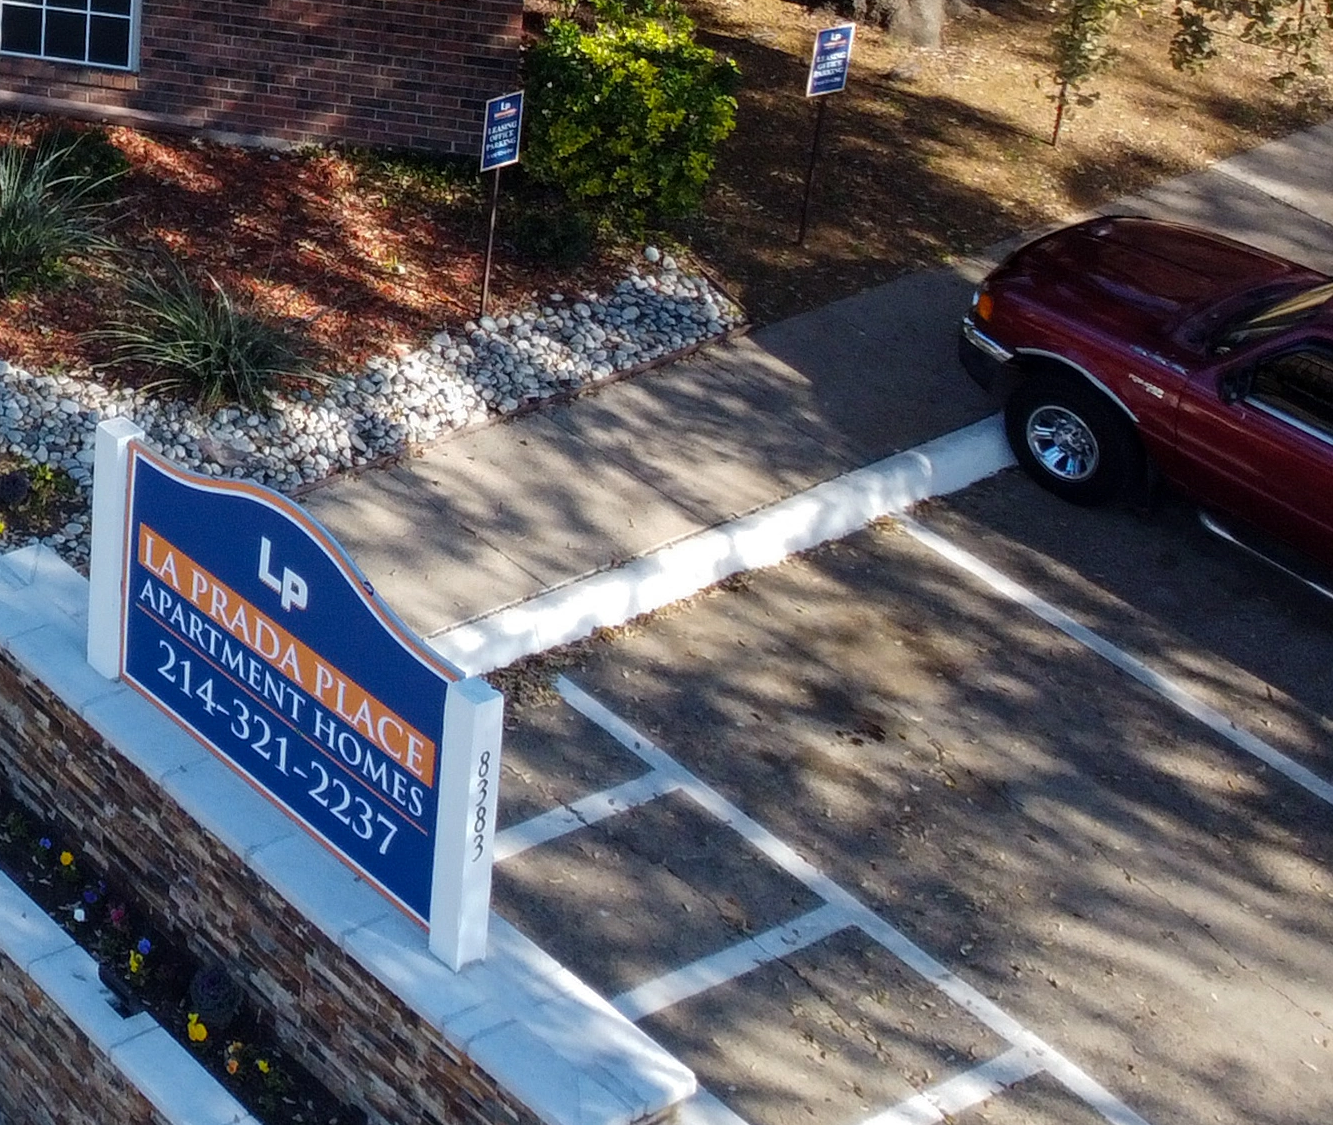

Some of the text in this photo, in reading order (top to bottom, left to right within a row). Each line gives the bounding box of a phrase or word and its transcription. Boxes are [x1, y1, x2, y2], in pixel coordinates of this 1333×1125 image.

[138, 578, 425, 818] APARTMENT HOMES
[144, 532, 425, 776] LA PRADA PLACE
[157, 639, 399, 856] 214-321-2237
[471, 750, 491, 863] 8383
